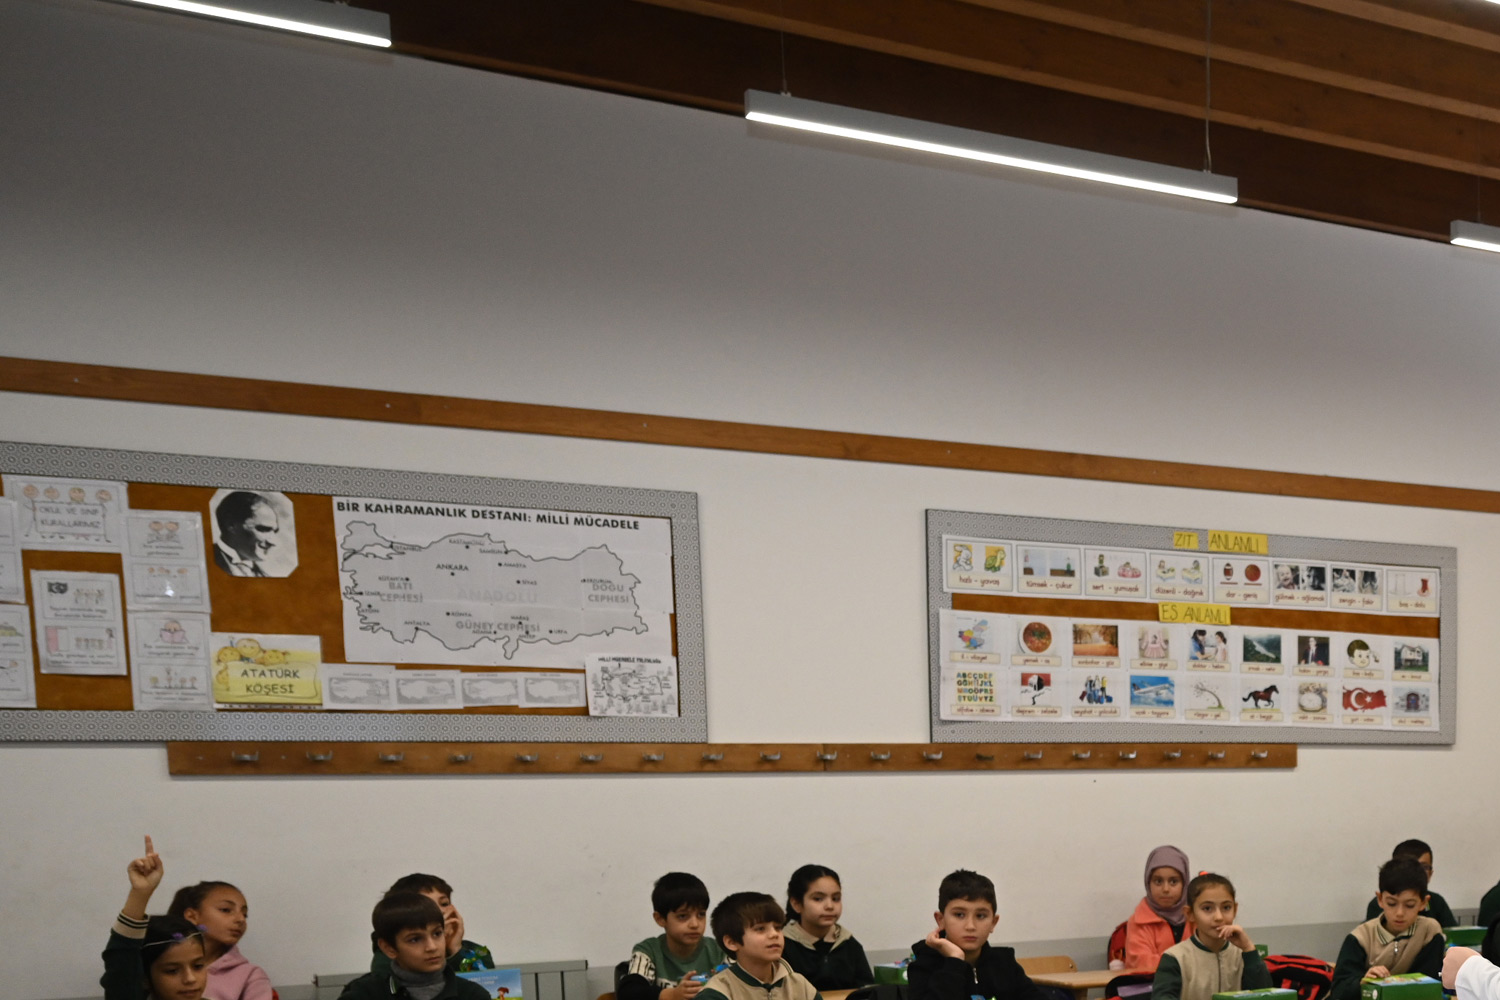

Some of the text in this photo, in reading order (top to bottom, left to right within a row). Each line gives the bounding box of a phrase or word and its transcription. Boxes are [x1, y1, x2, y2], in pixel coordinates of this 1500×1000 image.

[337, 500, 640, 530] BİR KAHRAMANLIK DESTANI: MİLLİ MÜCADELE
[1174, 533, 1260, 553] ZIT ANLAMLI
[436, 563, 469, 571] ANKARA
[388, 582, 412, 590] BATI
[1184, 606, 1228, 624] ANLAMLI
[456, 620, 493, 630] GÜNEY
[241, 668, 300, 679] ATATÜRK
[245, 683, 294, 696] KÖŞESİ
